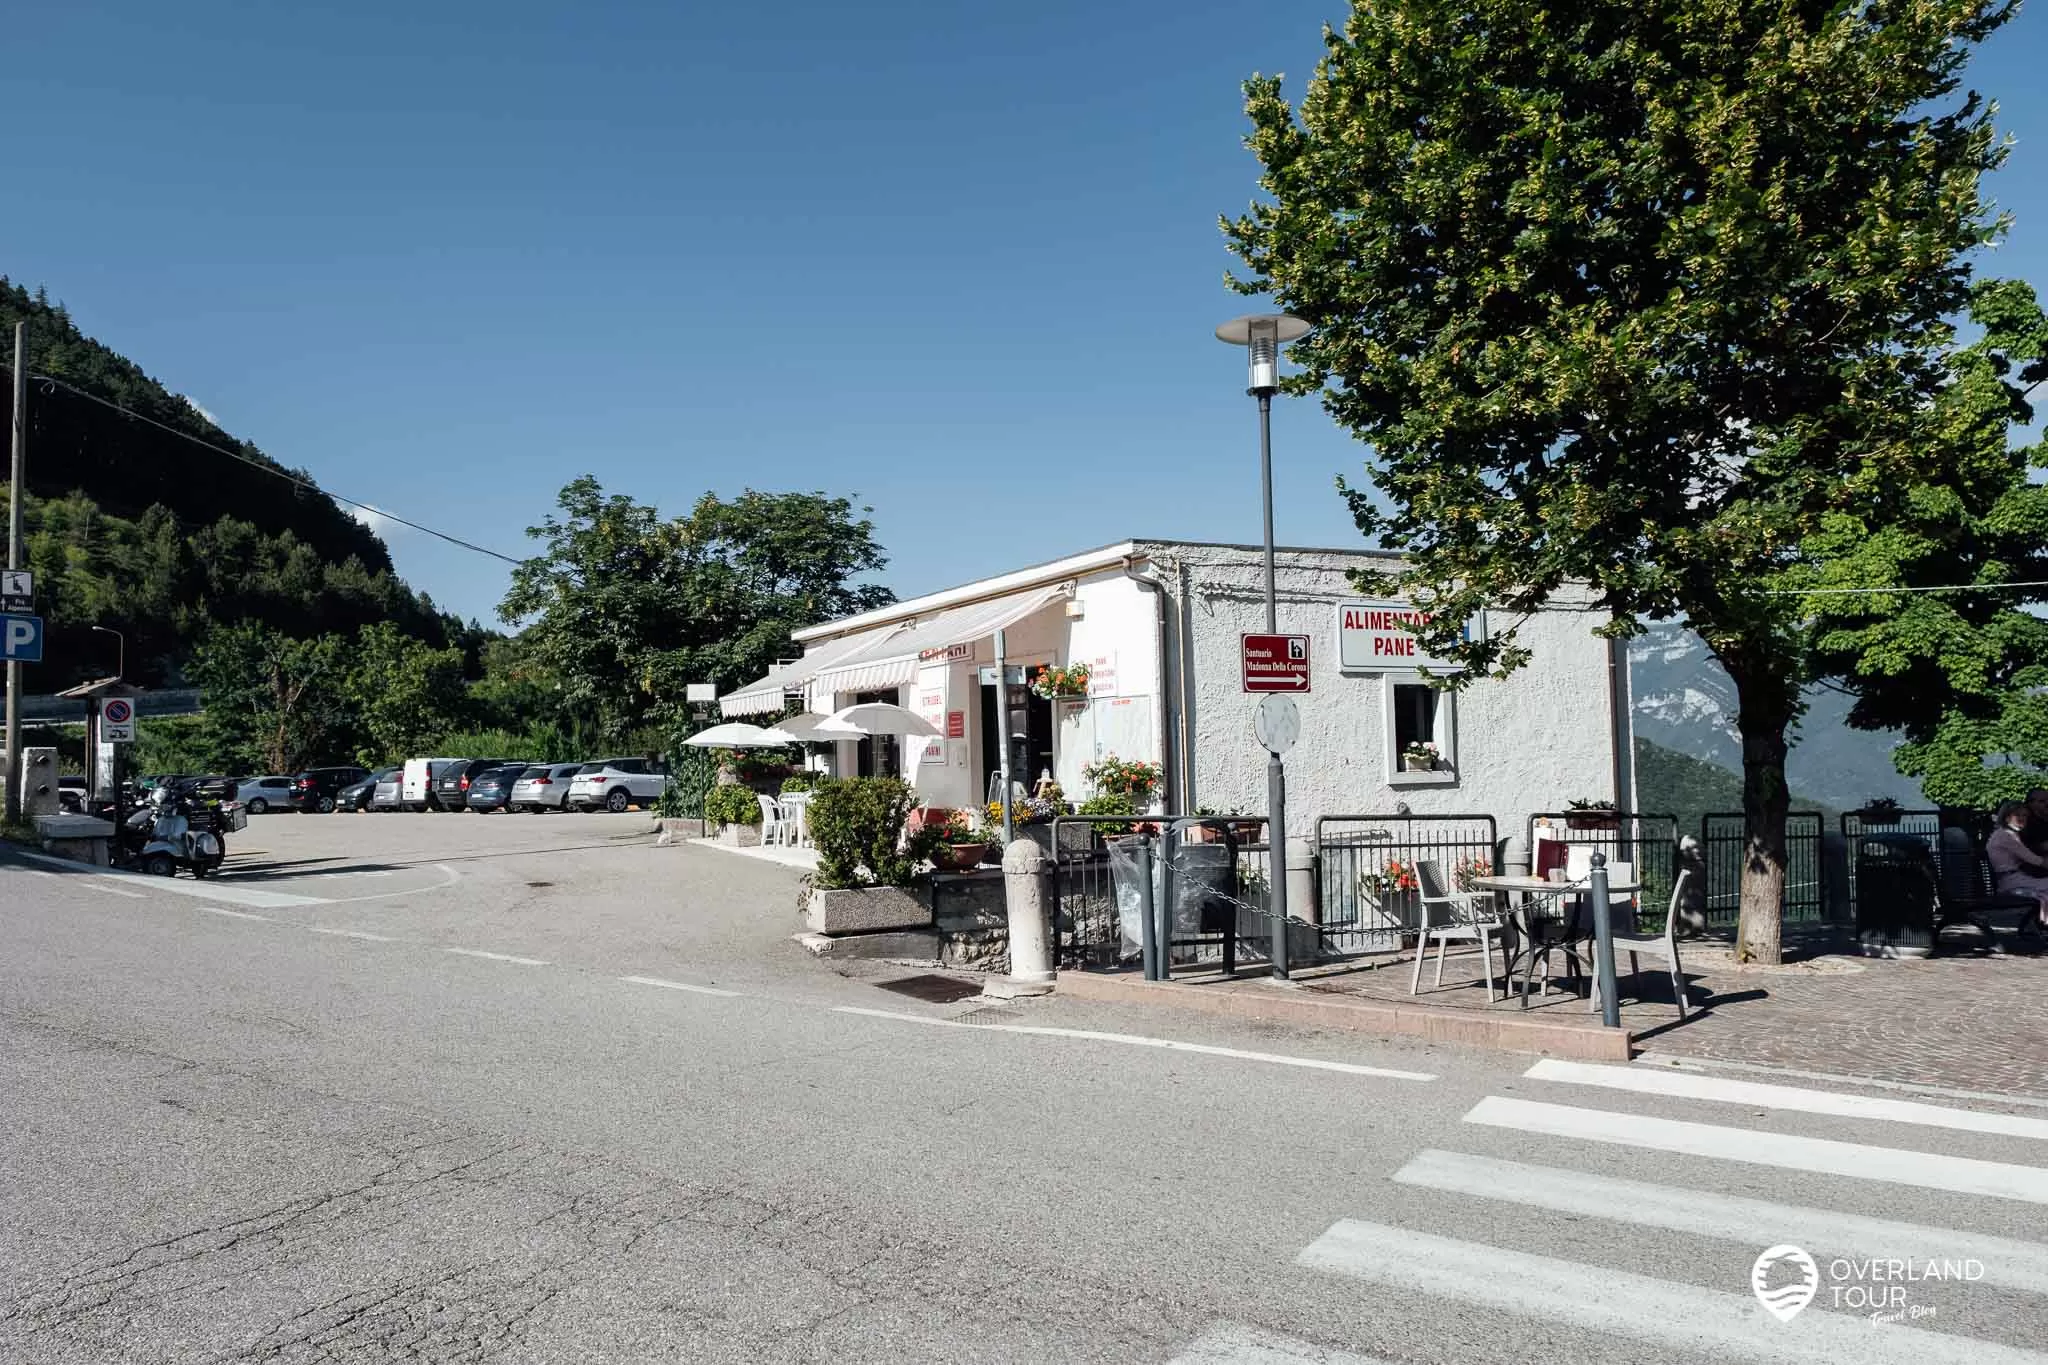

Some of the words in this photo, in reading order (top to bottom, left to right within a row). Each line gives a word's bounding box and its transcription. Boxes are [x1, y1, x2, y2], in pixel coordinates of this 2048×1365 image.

[1344, 610, 1433, 631] ALIMENTAR
[6, 619, 36, 655] P
[1374, 637, 1415, 656] PANE
[1245, 647, 1272, 658] Santuario
[1246, 661, 1272, 671] Madonna
[1272, 661, 1287, 671] Della
[1287, 661, 1307, 672] Corona
